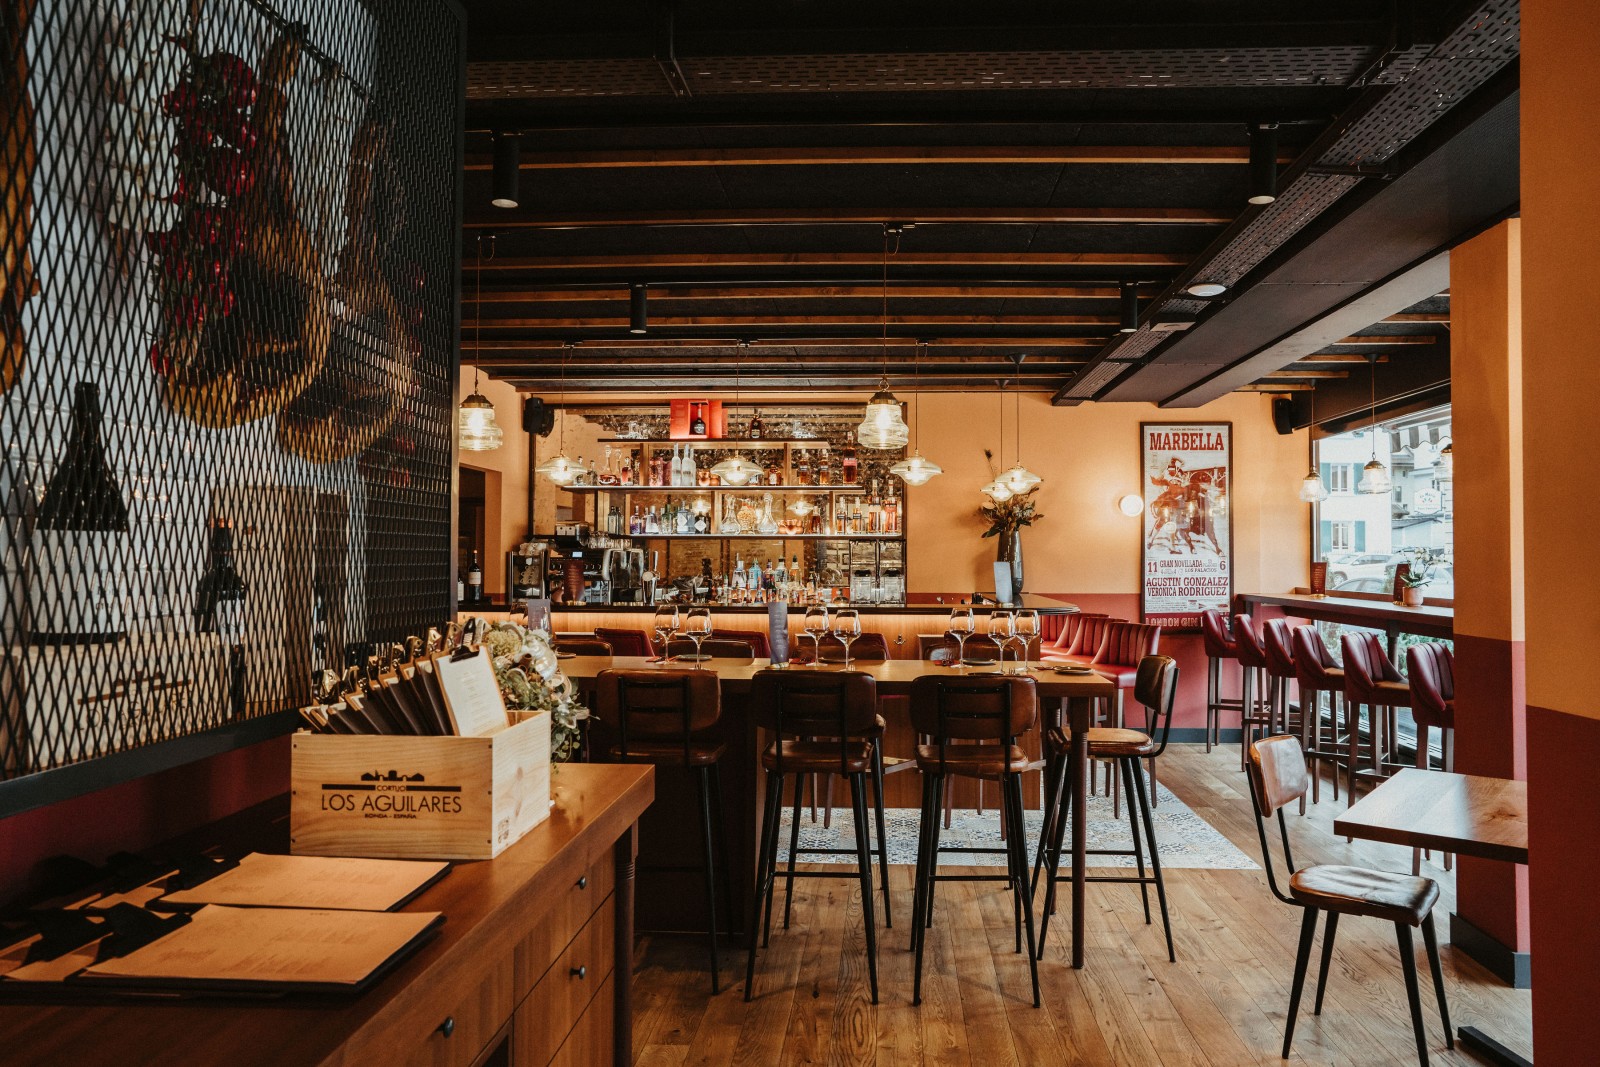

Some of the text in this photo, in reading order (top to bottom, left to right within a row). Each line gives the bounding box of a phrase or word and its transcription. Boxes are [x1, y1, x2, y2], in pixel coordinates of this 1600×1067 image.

[1149, 432, 1225, 451] MARBELLA
[1147, 561, 1158, 573] 11
[1175, 560, 1202, 568] NOVILLADA
[1219, 560, 1226, 571] 6
[1146, 577, 1228, 587] AGUSTIN GONZALEZ
[1147, 587, 1227, 597] VERONICA RODRIGUEZ
[1146, 618, 1198, 627] LONDON GIN
[321, 794, 462, 813] LOS AGUILARES
